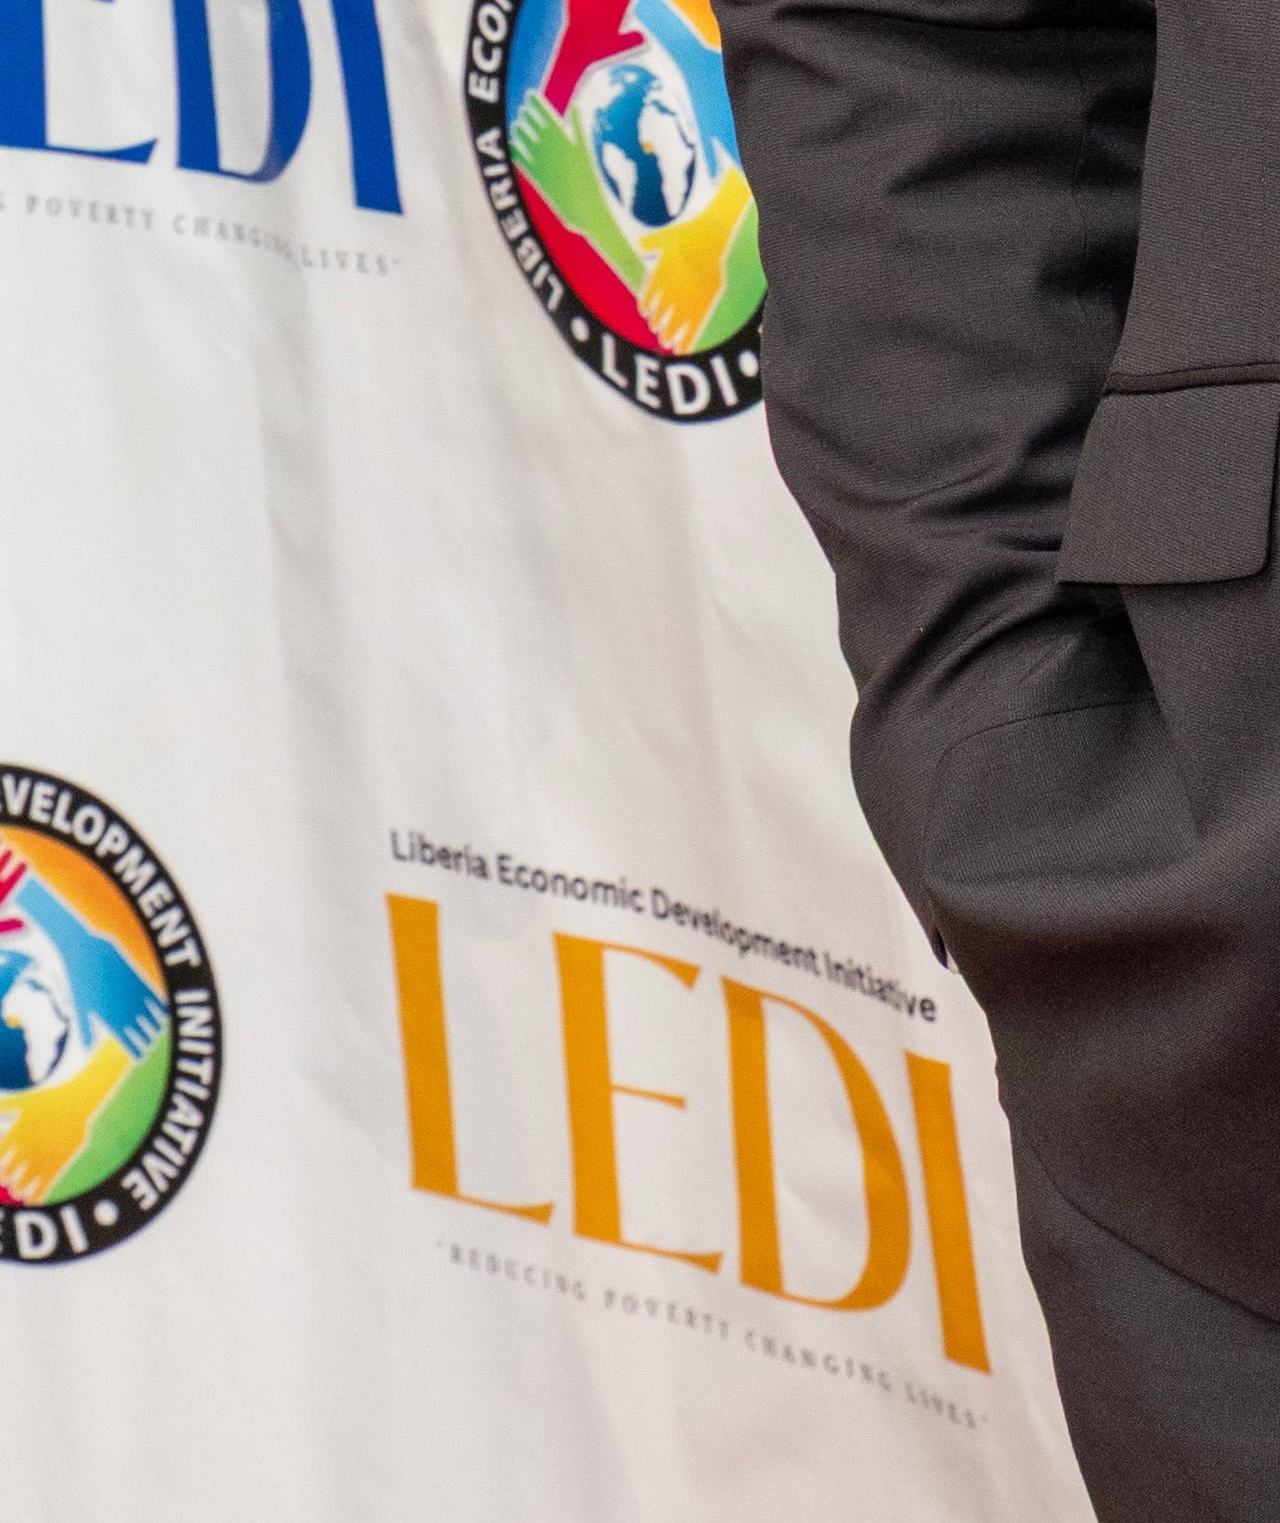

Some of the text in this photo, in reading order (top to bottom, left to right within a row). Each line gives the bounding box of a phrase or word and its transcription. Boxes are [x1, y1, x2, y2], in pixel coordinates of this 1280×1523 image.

[26, 194, 155, 231] POVERTY
[476, 128, 564, 311] LIBERIA
[602, 340, 738, 416] LEDI
[0, 774, 214, 1211] VELOPMENT INITIATIVE
[391, 831, 937, 1022] Liberia Economic Development Initiative
[385, 893, 993, 1375] LEDI
[0, 1203, 88, 1259] DI
[604, 1290, 731, 1342] POVERTY
[745, 1330, 891, 1393] CHANGING
